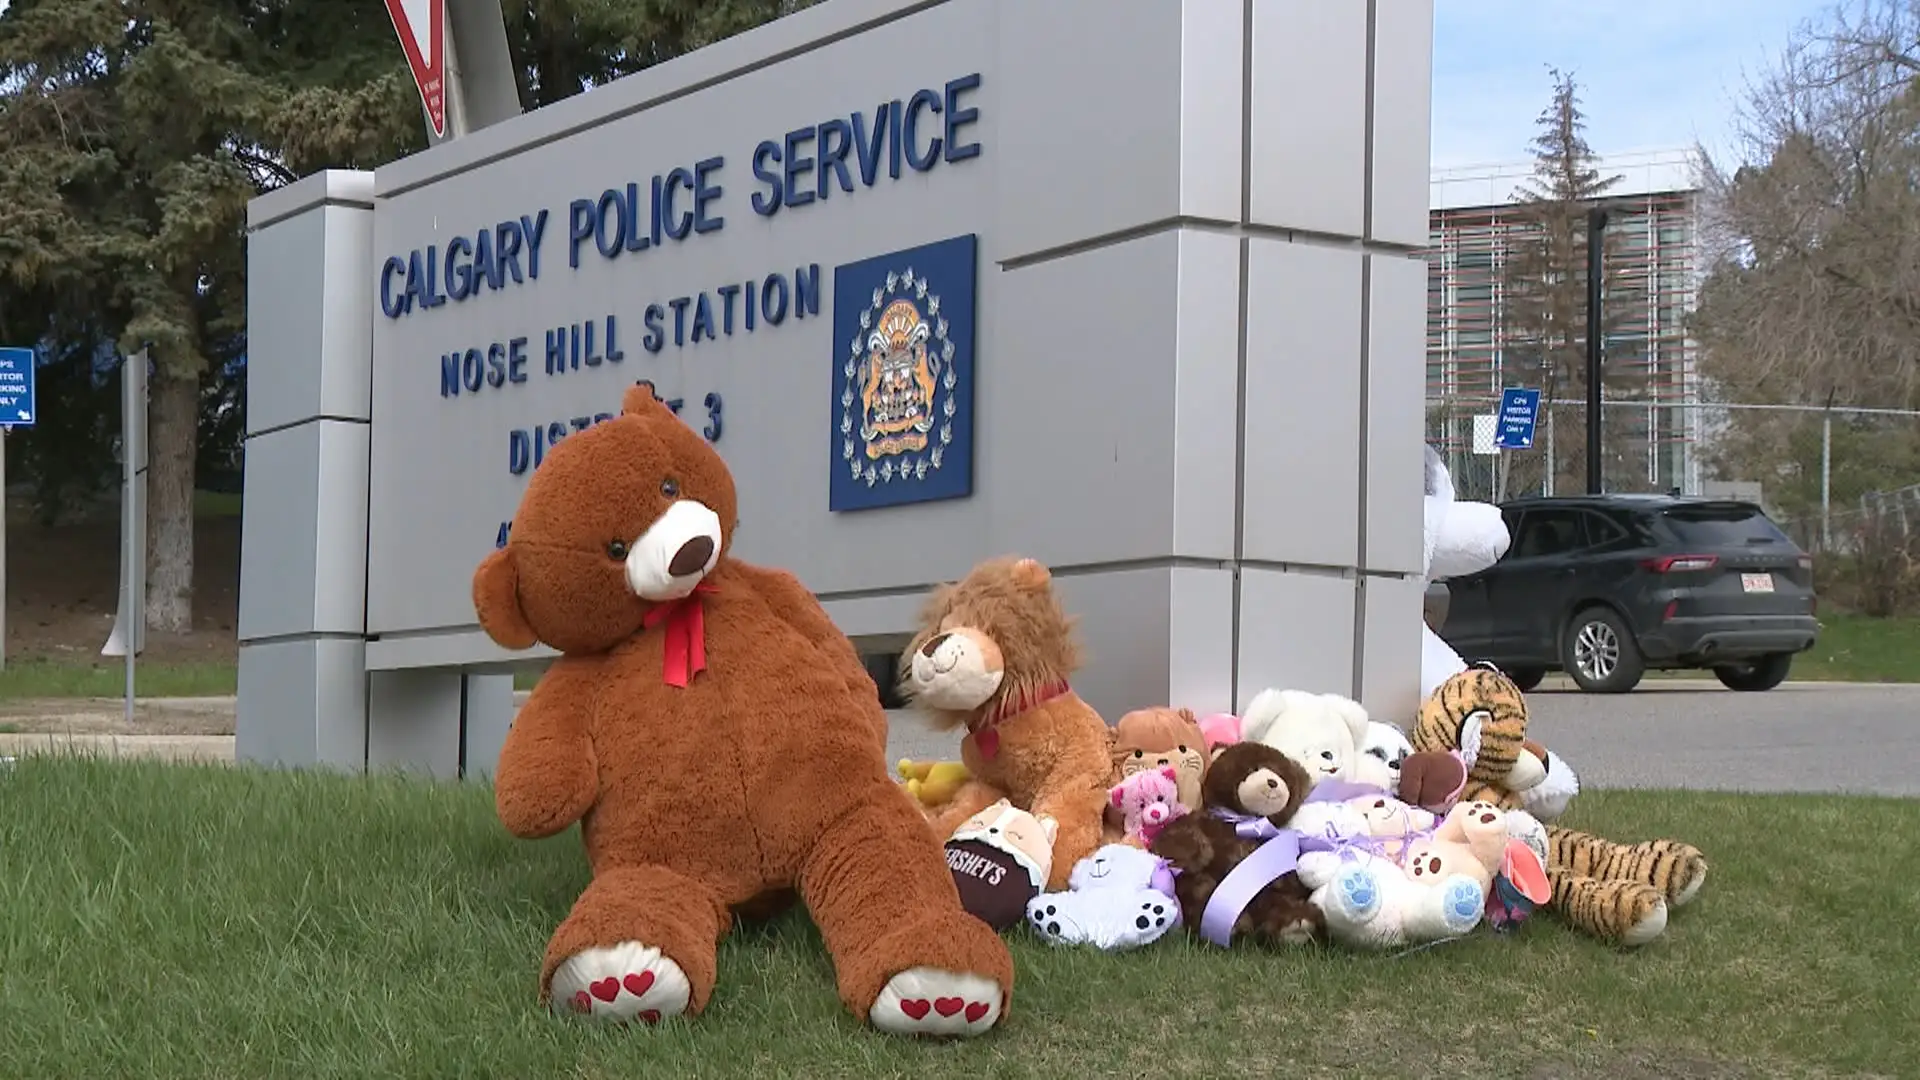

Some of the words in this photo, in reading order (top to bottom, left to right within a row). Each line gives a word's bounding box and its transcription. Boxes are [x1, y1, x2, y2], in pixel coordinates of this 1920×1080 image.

[380, 209, 549, 318] CALGARY
[569, 156, 723, 268] POLICE
[751, 73, 981, 216] SERVICE
[441, 337, 528, 398] NOSE
[545, 315, 624, 375] HILL
[643, 263, 820, 354] STATION
[0, 385, 26, 394] KING
[0, 397, 17, 405] NLY
[703, 391, 723, 442] 3
[945, 848, 1007, 885] ERSHEY'S
